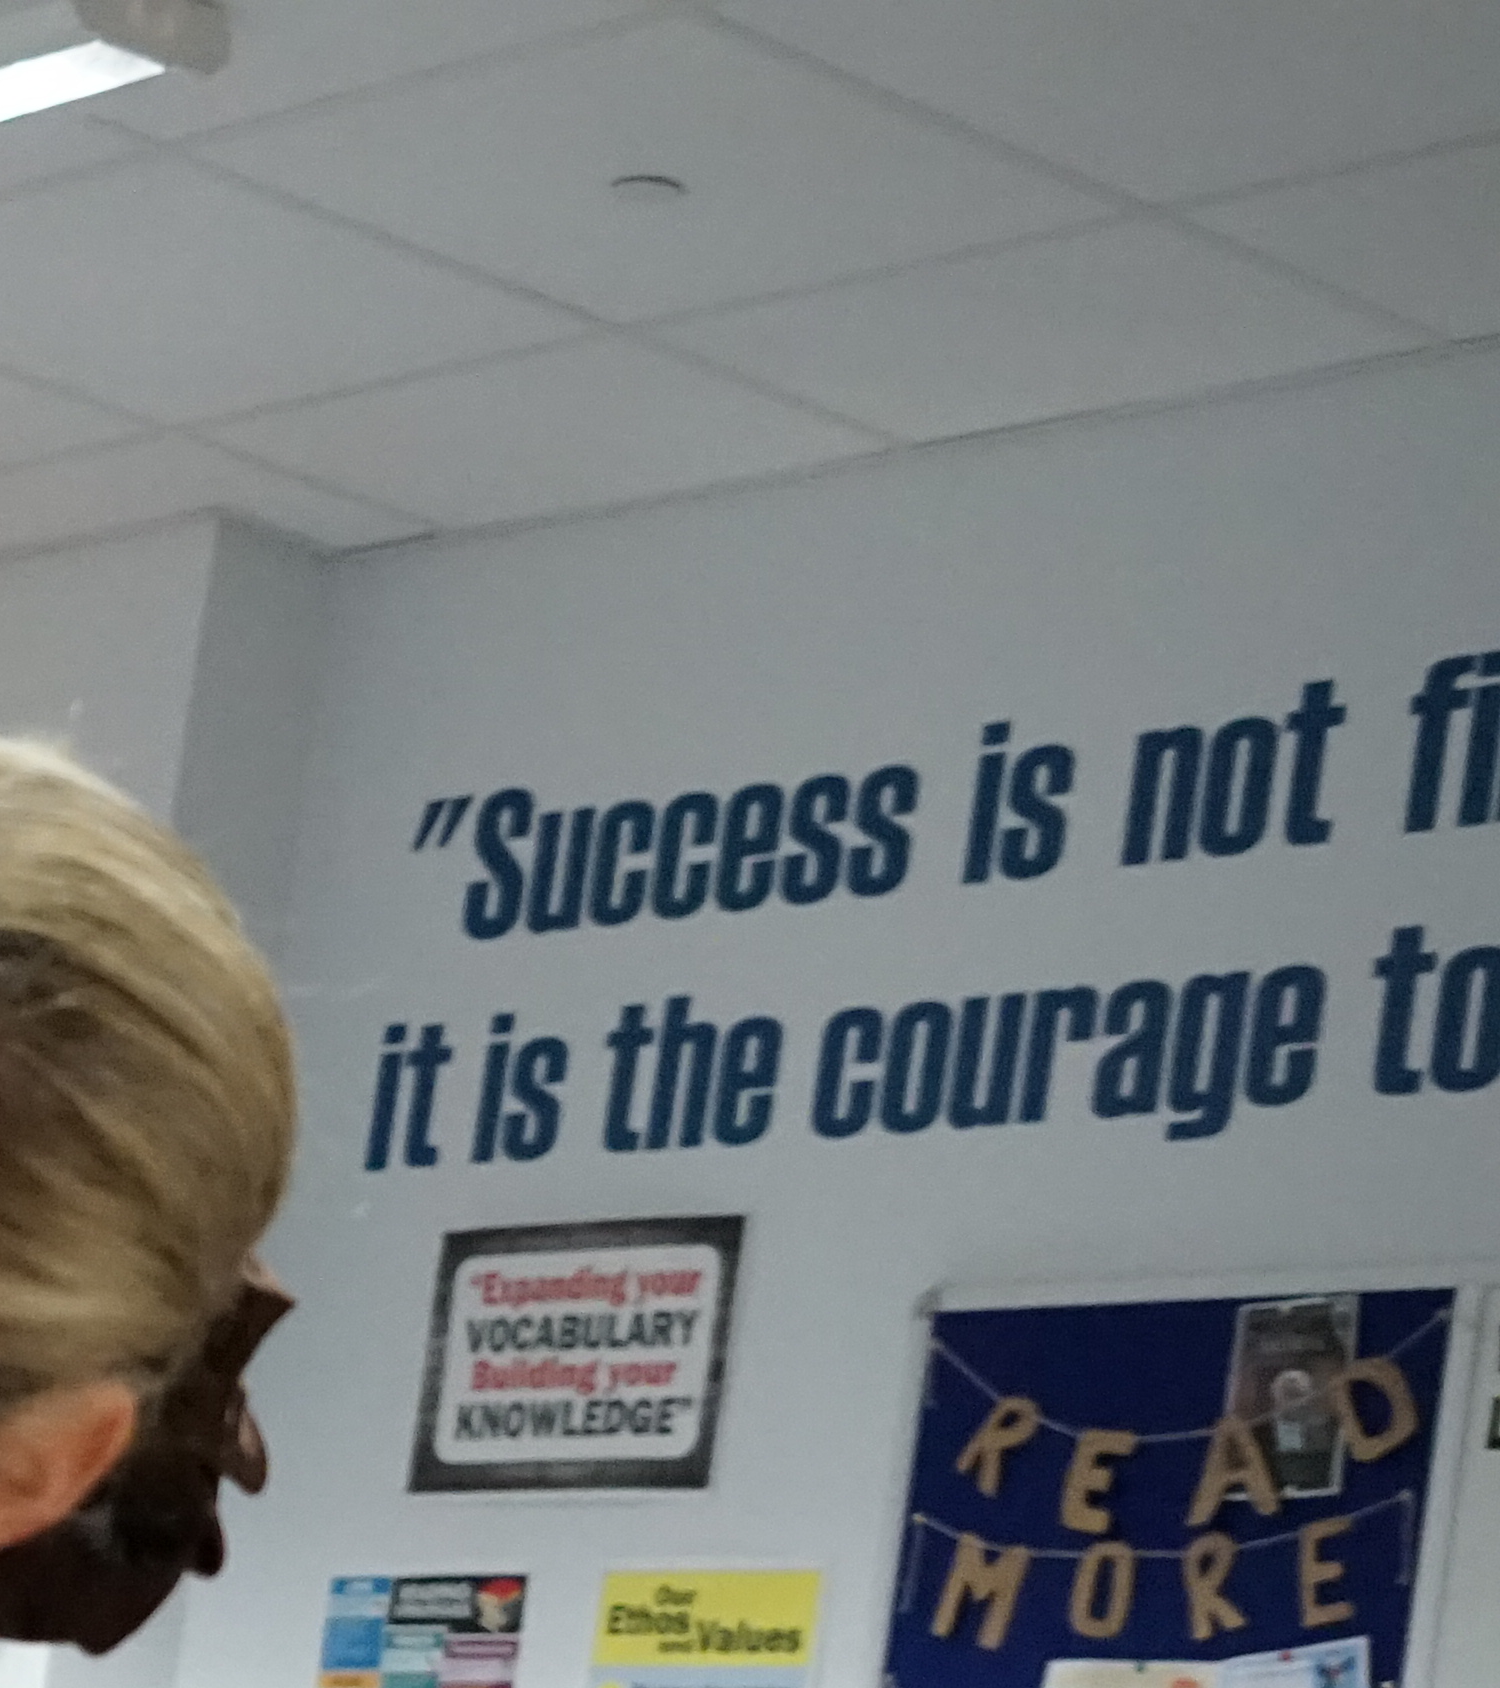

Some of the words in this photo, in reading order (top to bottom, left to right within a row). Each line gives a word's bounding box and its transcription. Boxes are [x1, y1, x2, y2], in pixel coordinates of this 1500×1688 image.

[411, 763, 919, 940] "Success
[962, 720, 1075, 884] is
[1120, 679, 1345, 866] not
[363, 1022, 451, 1171] it
[471, 1012, 568, 1164] is
[602, 995, 784, 1153] the
[811, 963, 1327, 1142] courage
[1373, 925, 1500, 1095] to
[470, 1268, 628, 1307] "Expanding
[635, 1270, 701, 1305] your
[466, 1309, 700, 1354] VOCABULARY
[471, 1357, 602, 1395] Building
[606, 1361, 677, 1393] your
[454, 1397, 693, 1441] KNOWLEDGE"
[954, 1356, 1420, 1534] READ
[654, 1584, 698, 1606] Our
[929, 1515, 1358, 1652] MORE
[605, 1604, 690, 1637] Ethos
[694, 1618, 803, 1655] Values
